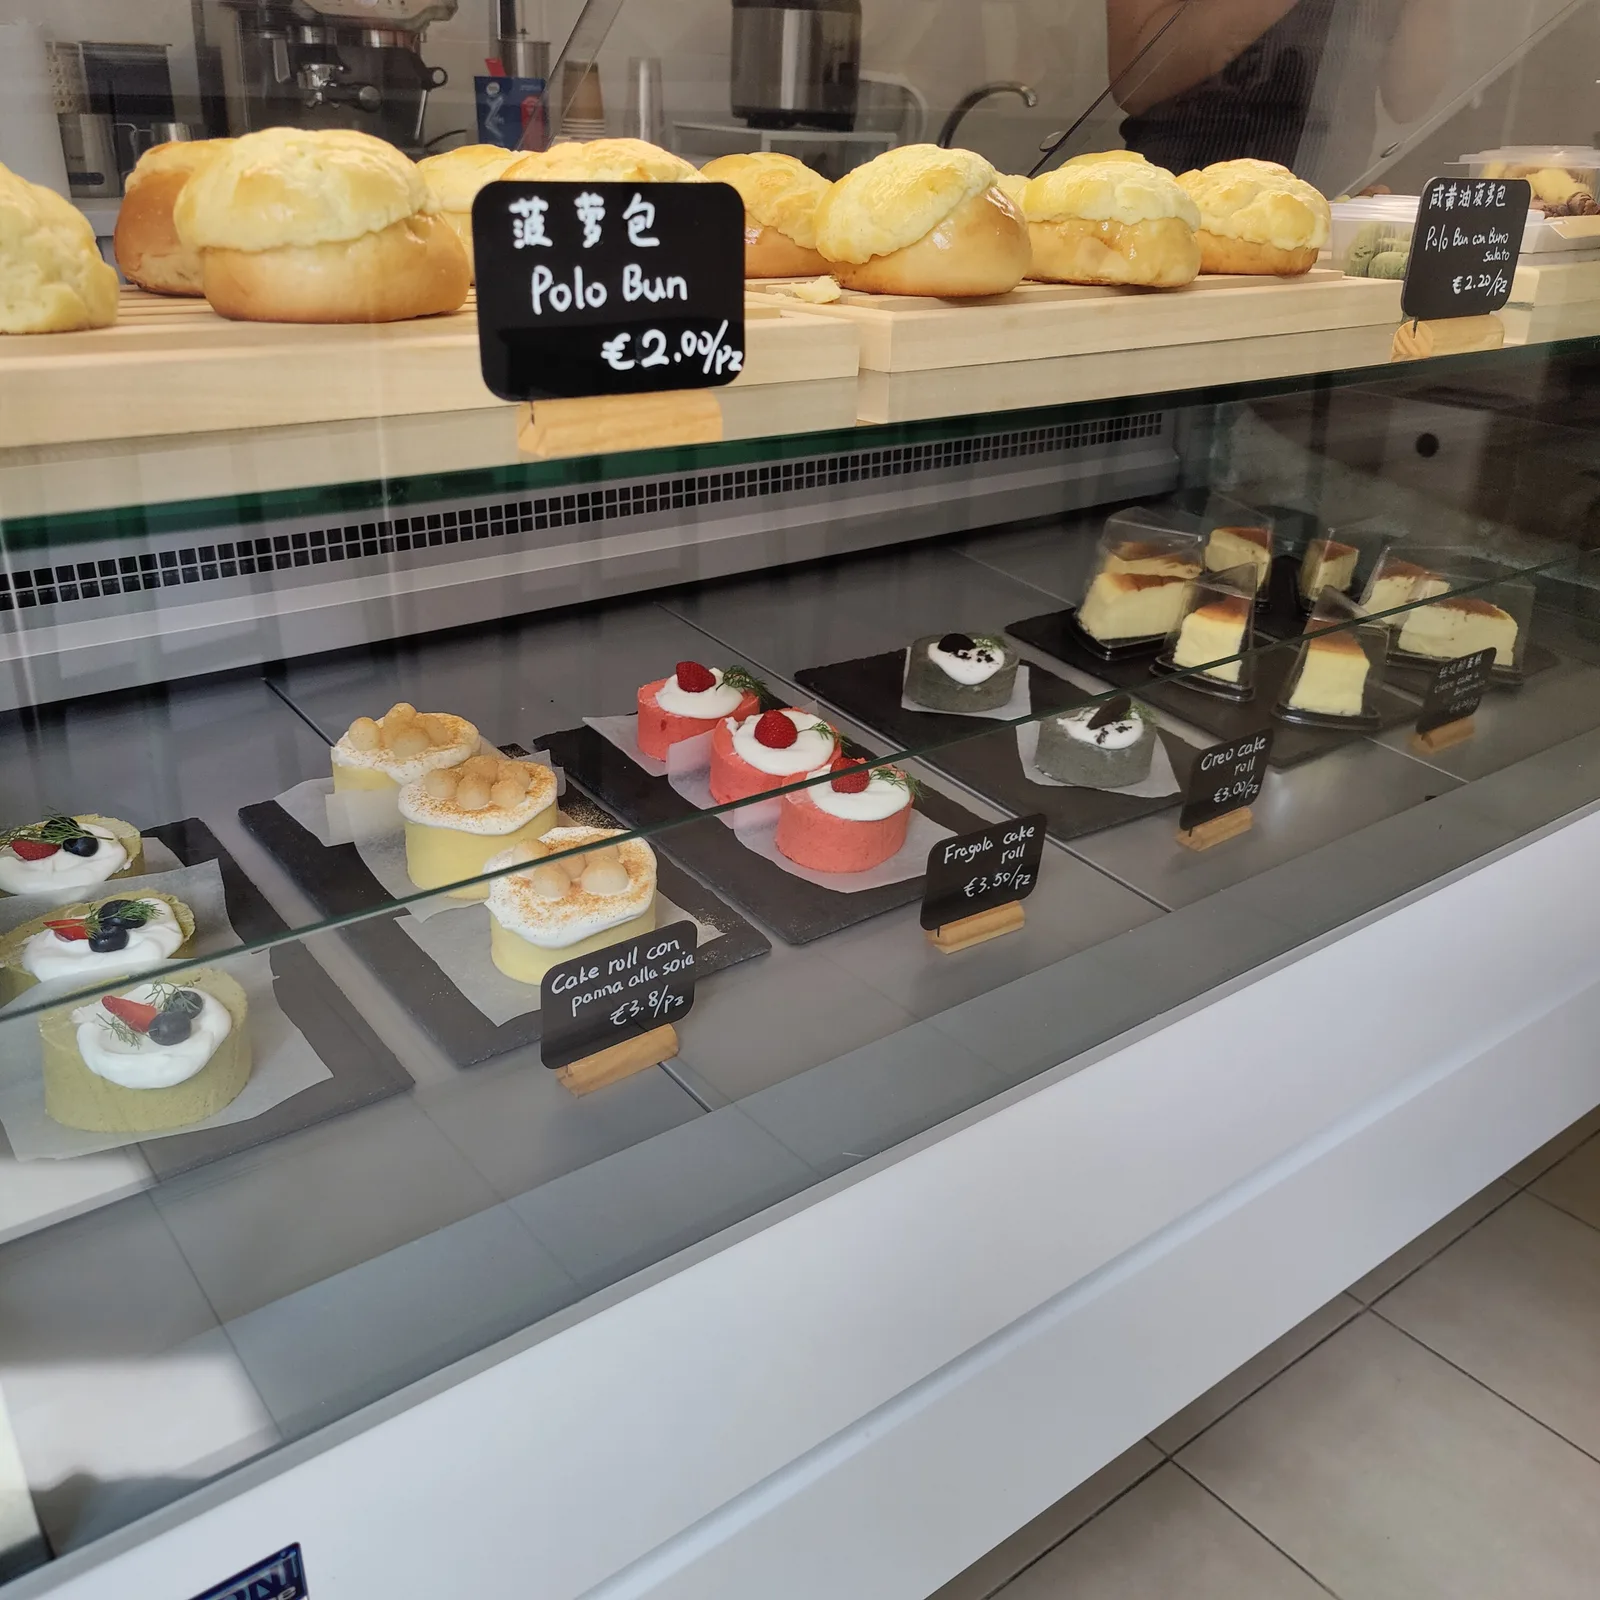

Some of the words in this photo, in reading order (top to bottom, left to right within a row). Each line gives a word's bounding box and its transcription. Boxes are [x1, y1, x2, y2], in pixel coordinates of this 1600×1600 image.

[509, 191, 660, 249] 菠萝包
[1425, 224, 1449, 252] Polo
[1452, 227, 1469, 246] Bun
[1472, 233, 1486, 245] con
[531, 265, 608, 315] Polo
[622, 263, 688, 303] Bun
[1201, 748, 1234, 771] Oreo
[1237, 736, 1266, 757] cake
[1234, 755, 1256, 776] roll
[943, 836, 994, 864] Fragola
[1003, 825, 1035, 845] cake
[1001, 843, 1026, 864] roll
[551, 966, 600, 995] Cake
[608, 946, 638, 975] roll
[646, 939, 680, 960] con
[572, 980, 624, 1017] panna
[628, 966, 658, 988] alla
[662, 951, 695, 976] soia
